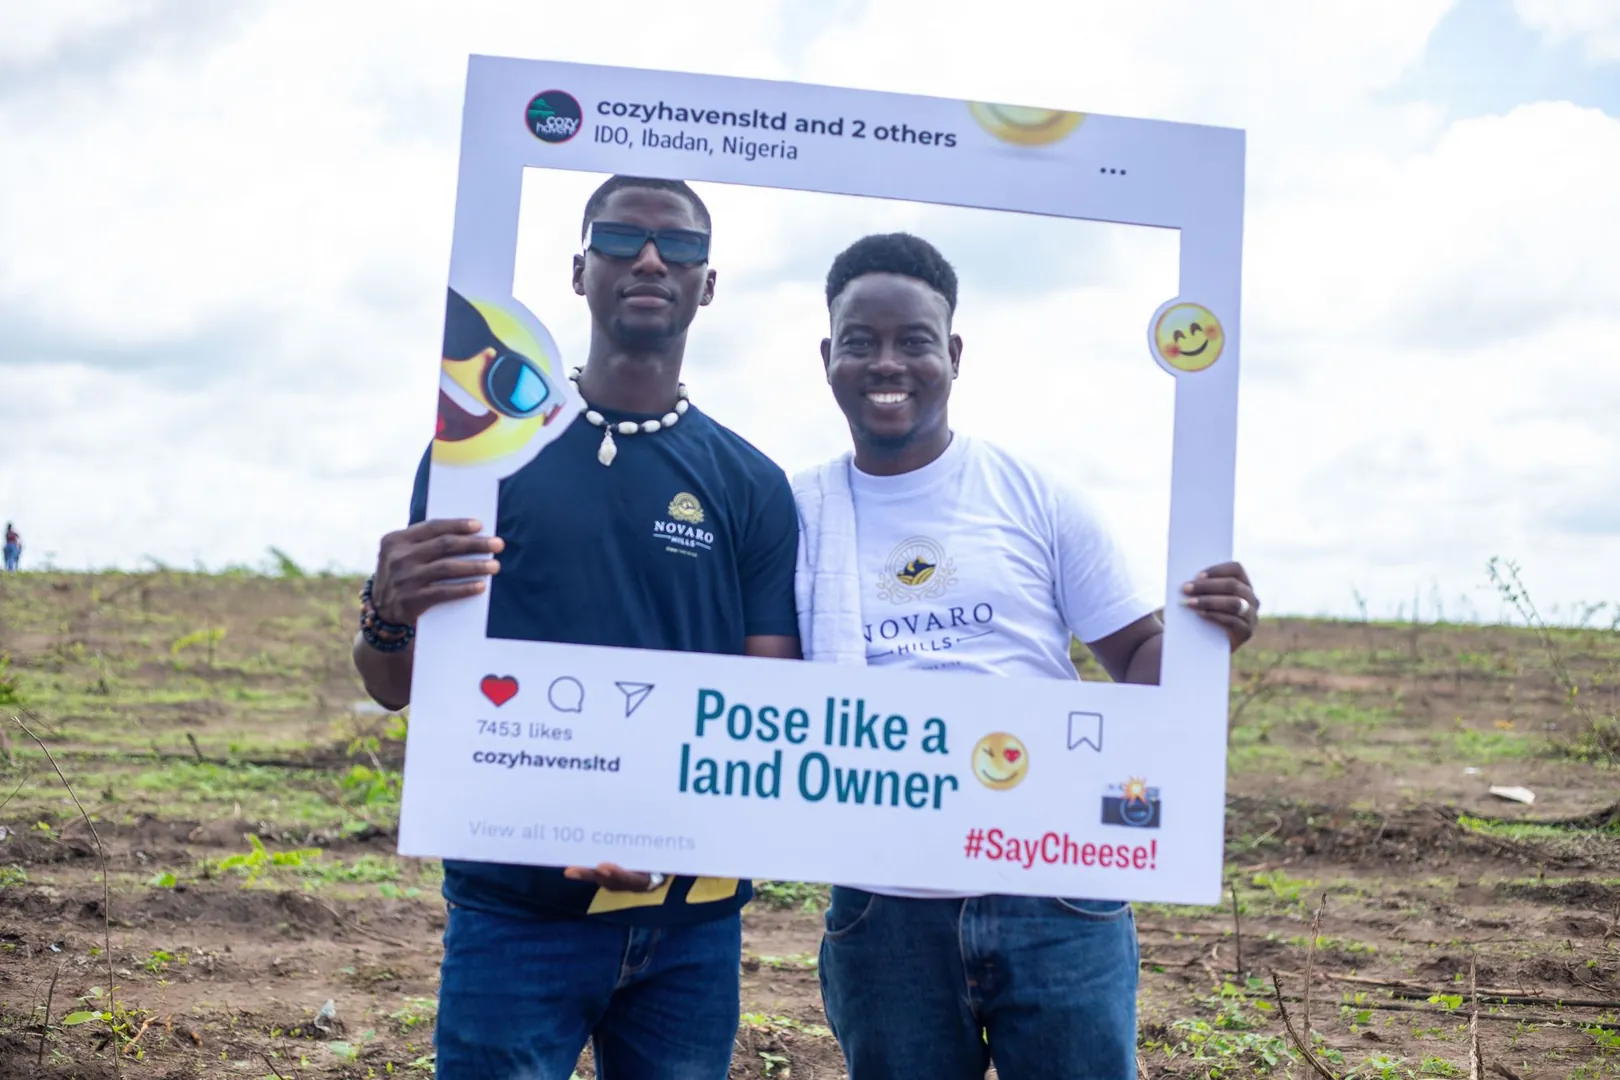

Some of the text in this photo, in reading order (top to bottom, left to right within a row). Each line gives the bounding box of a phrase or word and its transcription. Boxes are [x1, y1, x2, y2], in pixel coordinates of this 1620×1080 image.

[546, 116, 579, 135] cozy
[596, 100, 957, 148] cozyhavensltd and 2 others
[594, 125, 799, 161] IDO, Ibadan, Nigeria
[654, 520, 714, 544] NOVARO
[897, 636, 952, 656] HILLS
[477, 719, 573, 741] 7453 likes
[695, 688, 949, 754] Pose like a
[473, 750, 620, 772] cozyhavensltd
[678, 743, 960, 809] land Owner
[468, 820, 696, 851] View all 100 comments
[964, 828, 1159, 870] #SayCheese!
